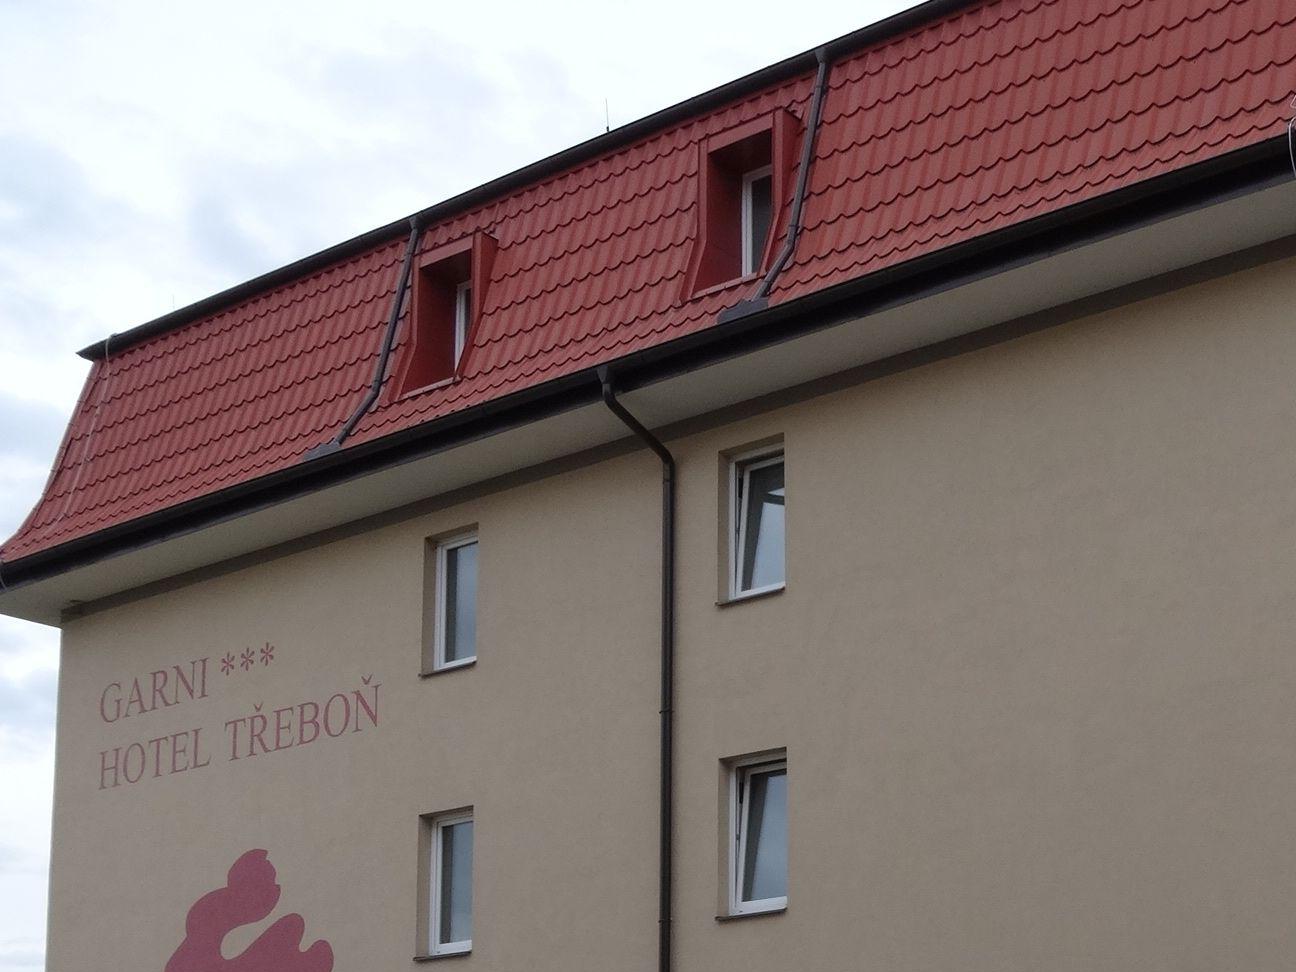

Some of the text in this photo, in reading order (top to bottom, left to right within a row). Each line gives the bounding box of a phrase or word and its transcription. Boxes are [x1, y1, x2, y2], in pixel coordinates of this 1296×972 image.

[98, 673, 383, 791] HOTEL TŘEBOŇ
[99, 656, 210, 723] GARNI
